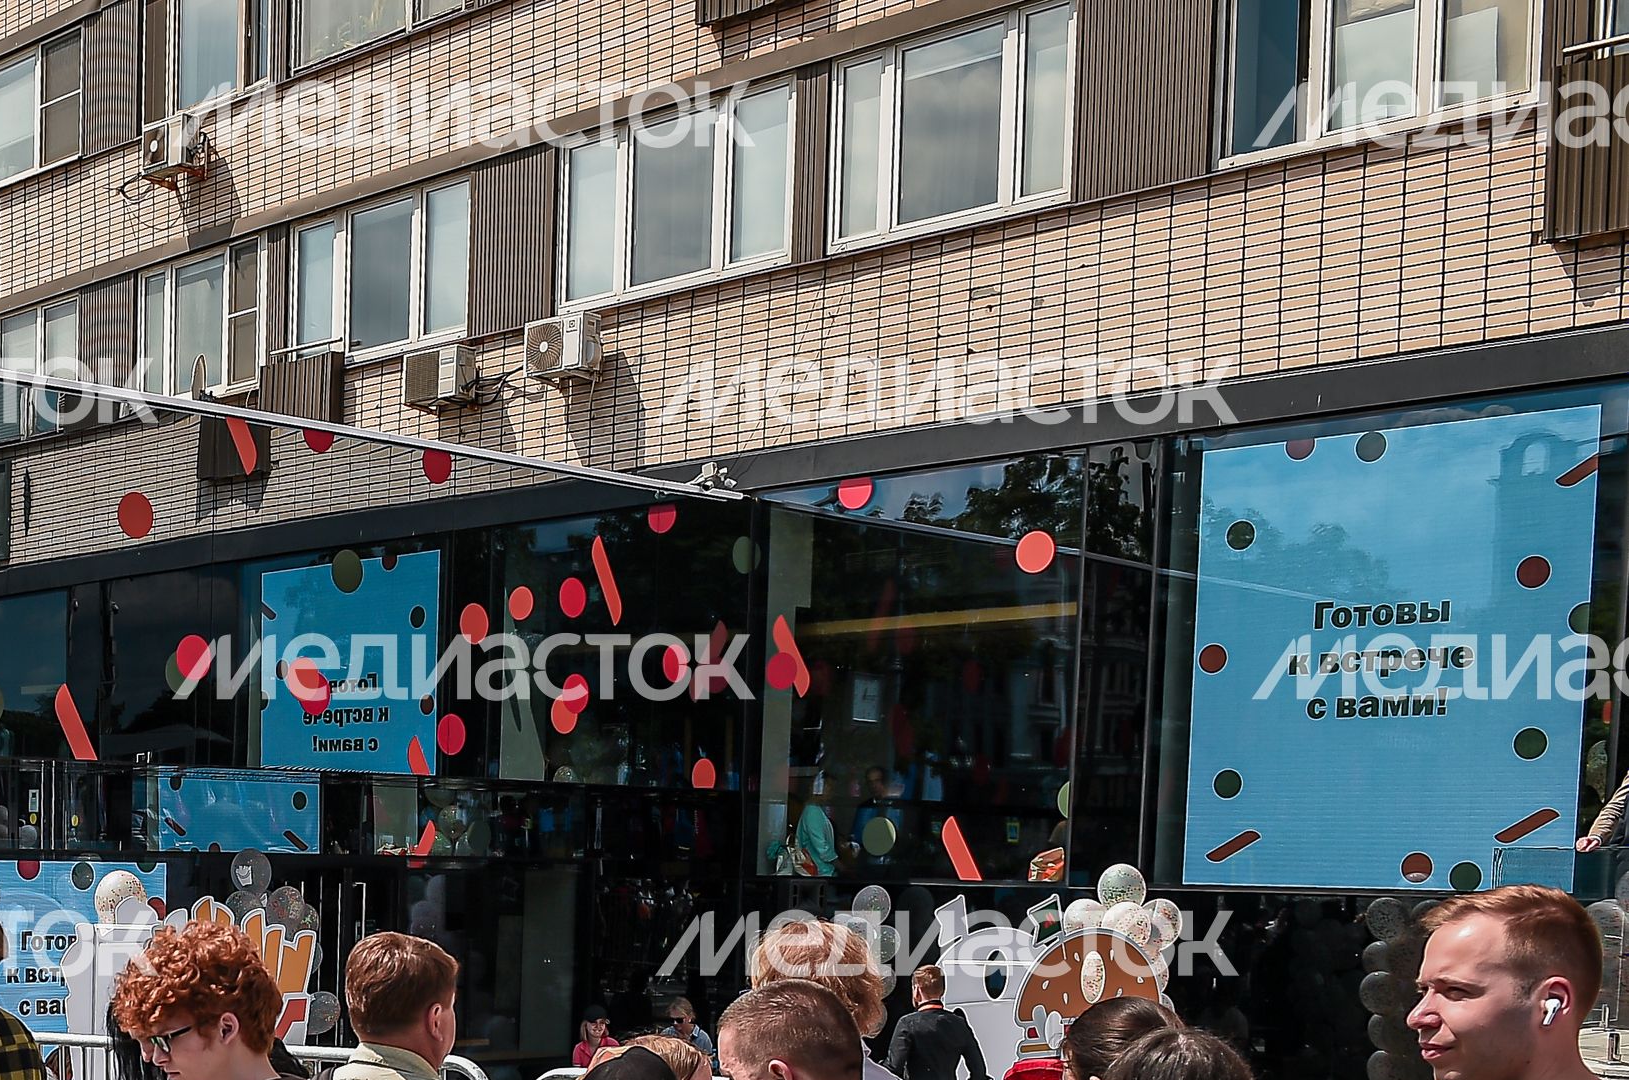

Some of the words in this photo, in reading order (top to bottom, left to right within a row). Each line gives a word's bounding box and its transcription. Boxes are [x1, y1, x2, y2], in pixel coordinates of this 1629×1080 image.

[1313, 599, 1452, 630] Готовы
[1287, 653, 1310, 677] к
[1319, 645, 1475, 678] встрече
[1306, 696, 1328, 720] с
[1334, 686, 1450, 719] вами!
